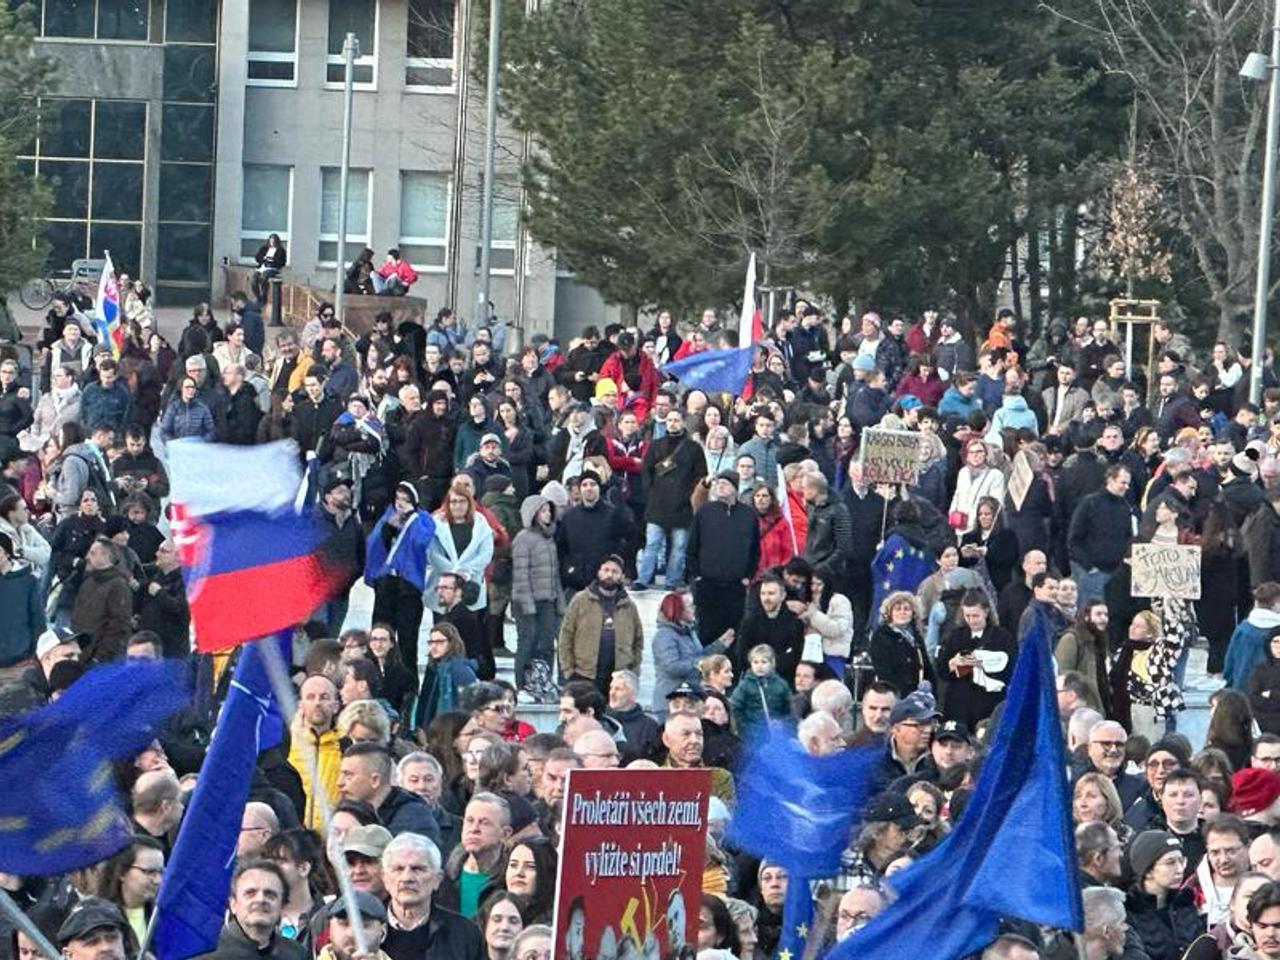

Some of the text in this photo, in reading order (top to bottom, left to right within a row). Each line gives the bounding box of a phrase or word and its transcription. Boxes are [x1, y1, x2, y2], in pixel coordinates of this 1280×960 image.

[572, 789, 703, 832] Proletáři všech zemí,
[630, 842, 641, 877] si
[642, 841, 682, 885] prdel!
